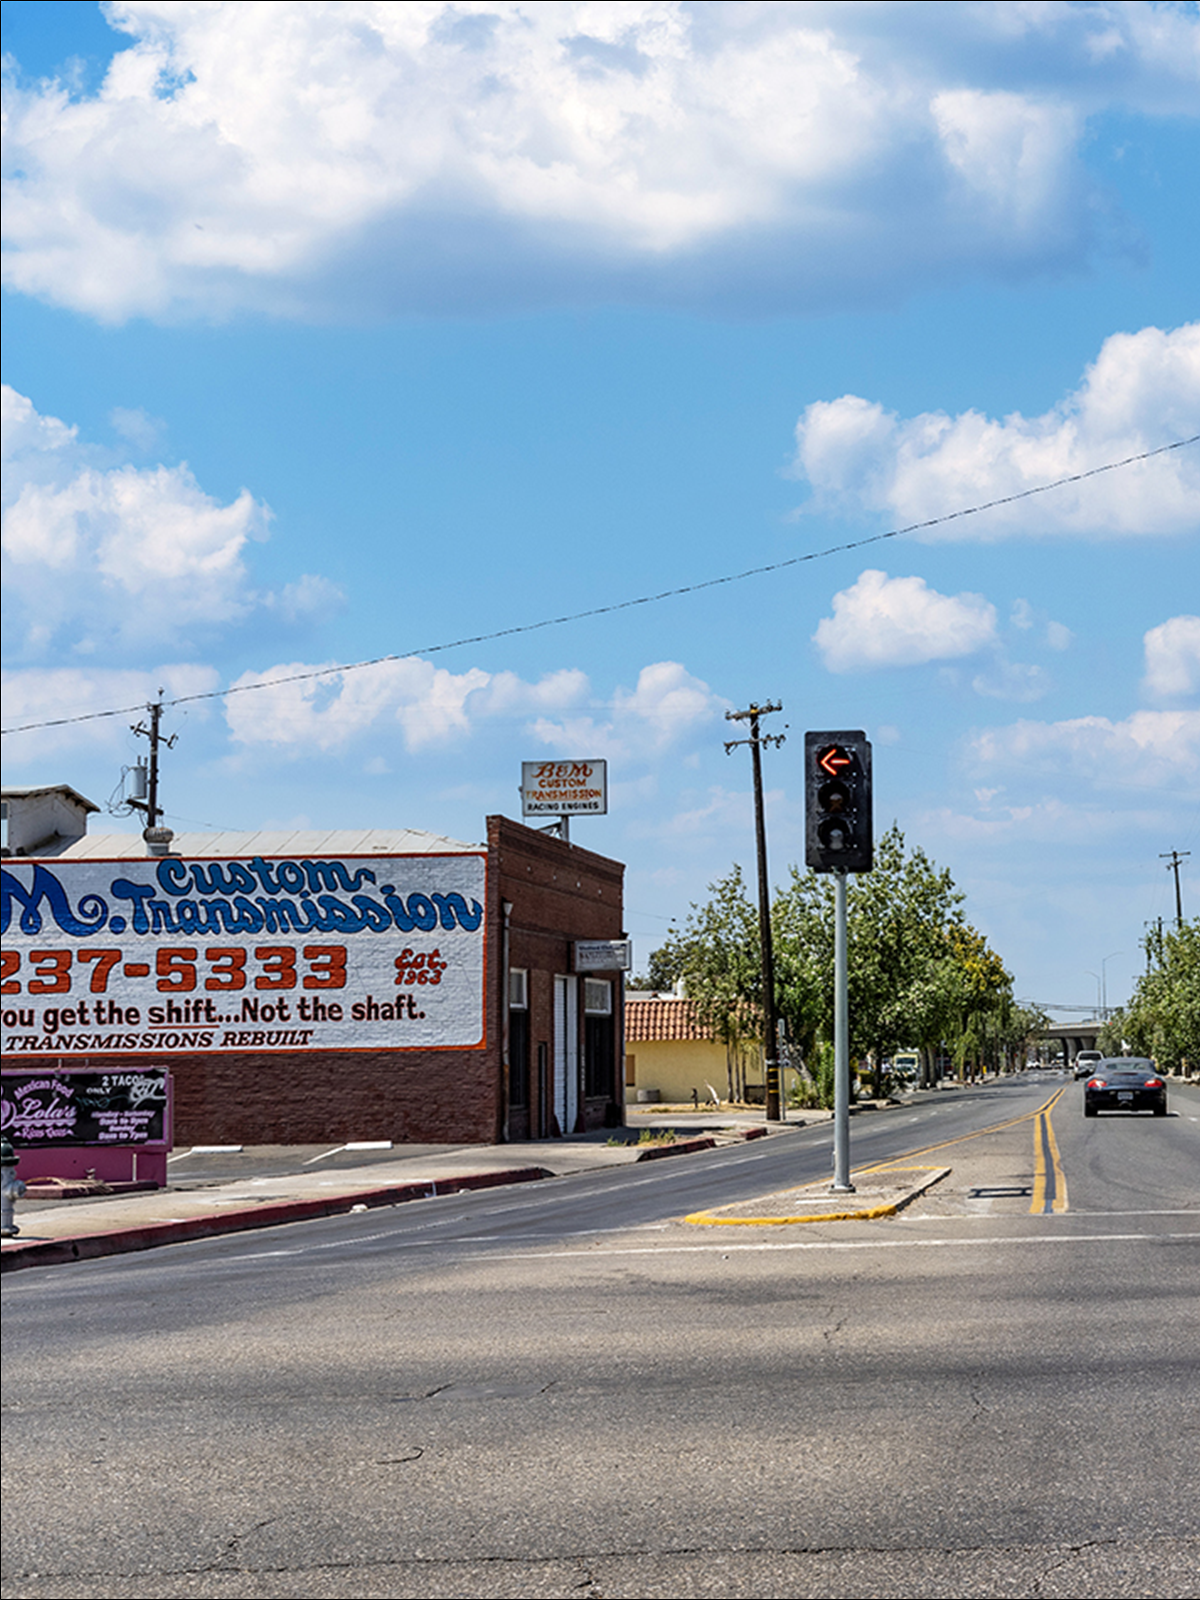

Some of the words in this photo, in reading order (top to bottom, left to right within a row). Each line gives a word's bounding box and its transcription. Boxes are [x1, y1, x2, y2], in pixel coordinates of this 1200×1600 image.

[531, 762, 593, 778] B&M
[538, 779, 586, 788] CUSTOM
[525, 789, 602, 800] TRANSMISSION
[527, 803, 559, 811] RACING
[561, 801, 599, 810] ENGINES
[156, 857, 376, 897] Custom
[110, 878, 484, 935] Transmission
[394, 970, 442, 985] 1963
[1, 1009, 34, 1027] ou
[43, 1001, 89, 1033] get
[94, 1000, 140, 1025] the
[297, 997, 343, 1021] the
[351, 995, 426, 1021] shaft.
[6, 1032, 214, 1051] TRANSMISSIONS
[220, 1030, 314, 1047] REBUILT
[14, 1080, 51, 1100] Mexican
[51, 1079, 74, 1098] Food
[102, 1076, 109, 1087] 2
[86, 1087, 112, 1095] ONLY
[15, 1098, 77, 1119] Lola's
